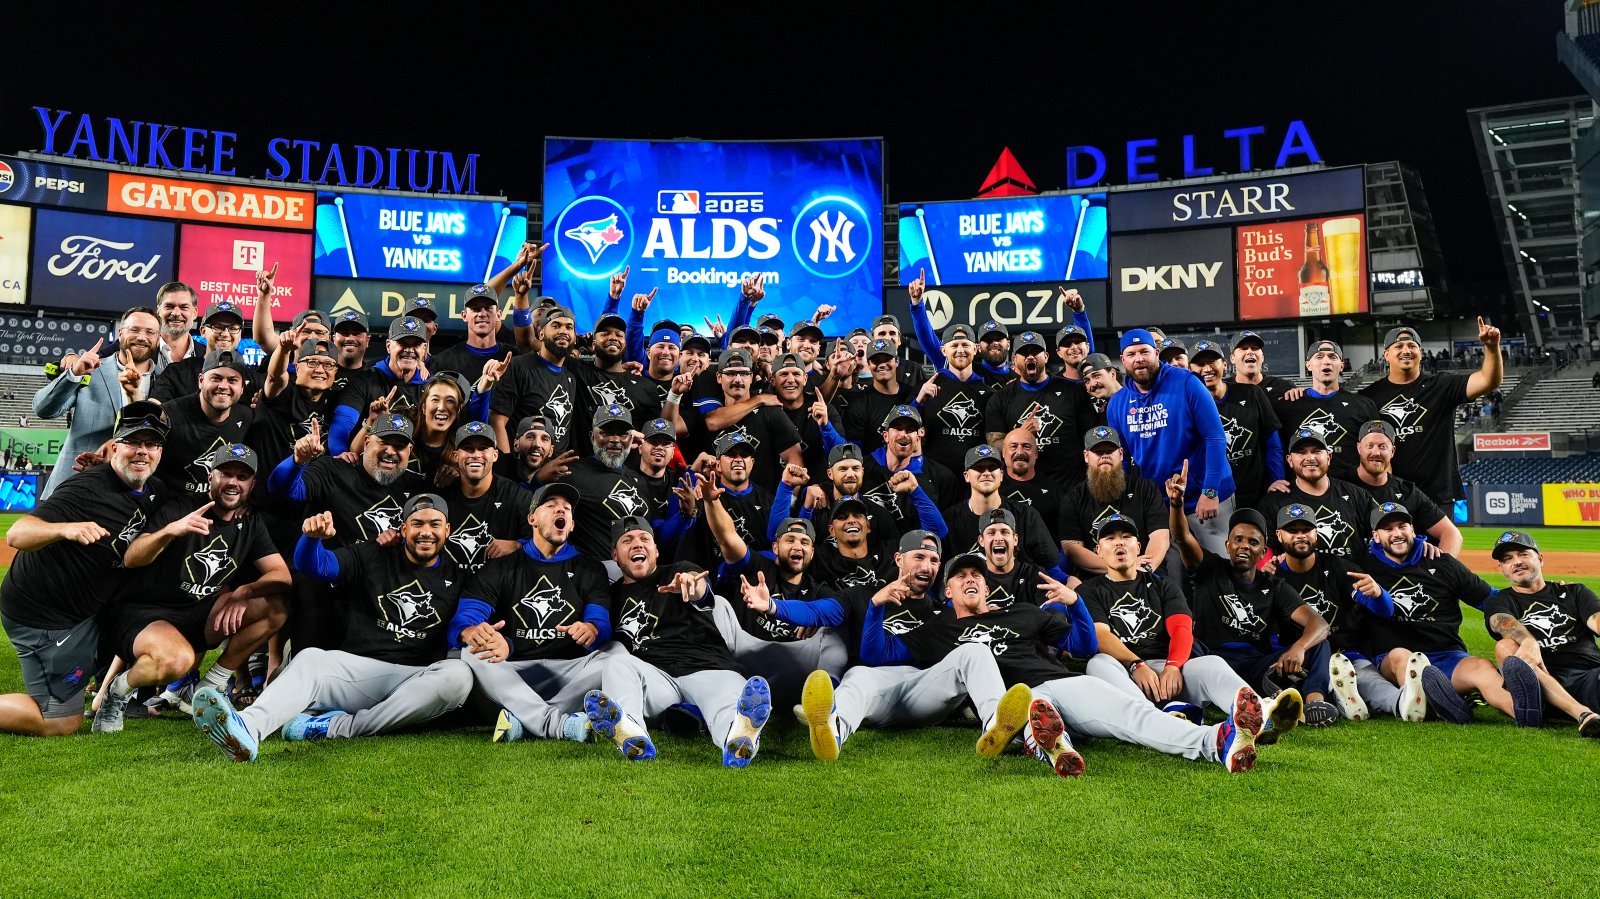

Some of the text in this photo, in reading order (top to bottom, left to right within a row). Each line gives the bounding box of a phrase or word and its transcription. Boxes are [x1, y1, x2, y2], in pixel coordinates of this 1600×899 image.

[33, 105, 480, 195] YANKEE STADIUM
[1067, 120, 1321, 187] DELTA
[35, 176, 85, 194] PEPSI
[121, 182, 304, 222] GATORADE
[705, 199, 764, 213] 2025
[1173, 183, 1295, 221] STARR
[379, 209, 465, 234] BLUE JAYS
[959, 211, 1044, 236] BLUE JAYS
[641, 217, 781, 260] ALDS
[1242, 229, 1284, 247] This
[47, 235, 161, 285] Ford
[382, 246, 461, 271] YANKEES
[963, 248, 1042, 273] YANKEES
[1244, 245, 1293, 264] Bud's
[1121, 261, 1223, 292] DKNY
[1245, 265, 1275, 280] For
[200, 281, 230, 293] BEST
[1244, 281, 1284, 297] You.
[211, 294, 224, 304] IN
[969, 288, 1078, 326] razr
[0, 329, 65, 344] New York Yankees
[1146, 409, 1168, 423] JAYS
[950, 428, 972, 436] ALCS
[1395, 426, 1414, 436] LCS
[1036, 437, 1052, 446] LCS
[1476, 438, 1519, 447] Reebok
[1563, 489, 1586, 499] WHO
[1490, 498, 1506, 508] GS
[386, 621, 416, 638] ALCS
[525, 629, 556, 639] ALCS
[1537, 635, 1568, 648] ALCS
